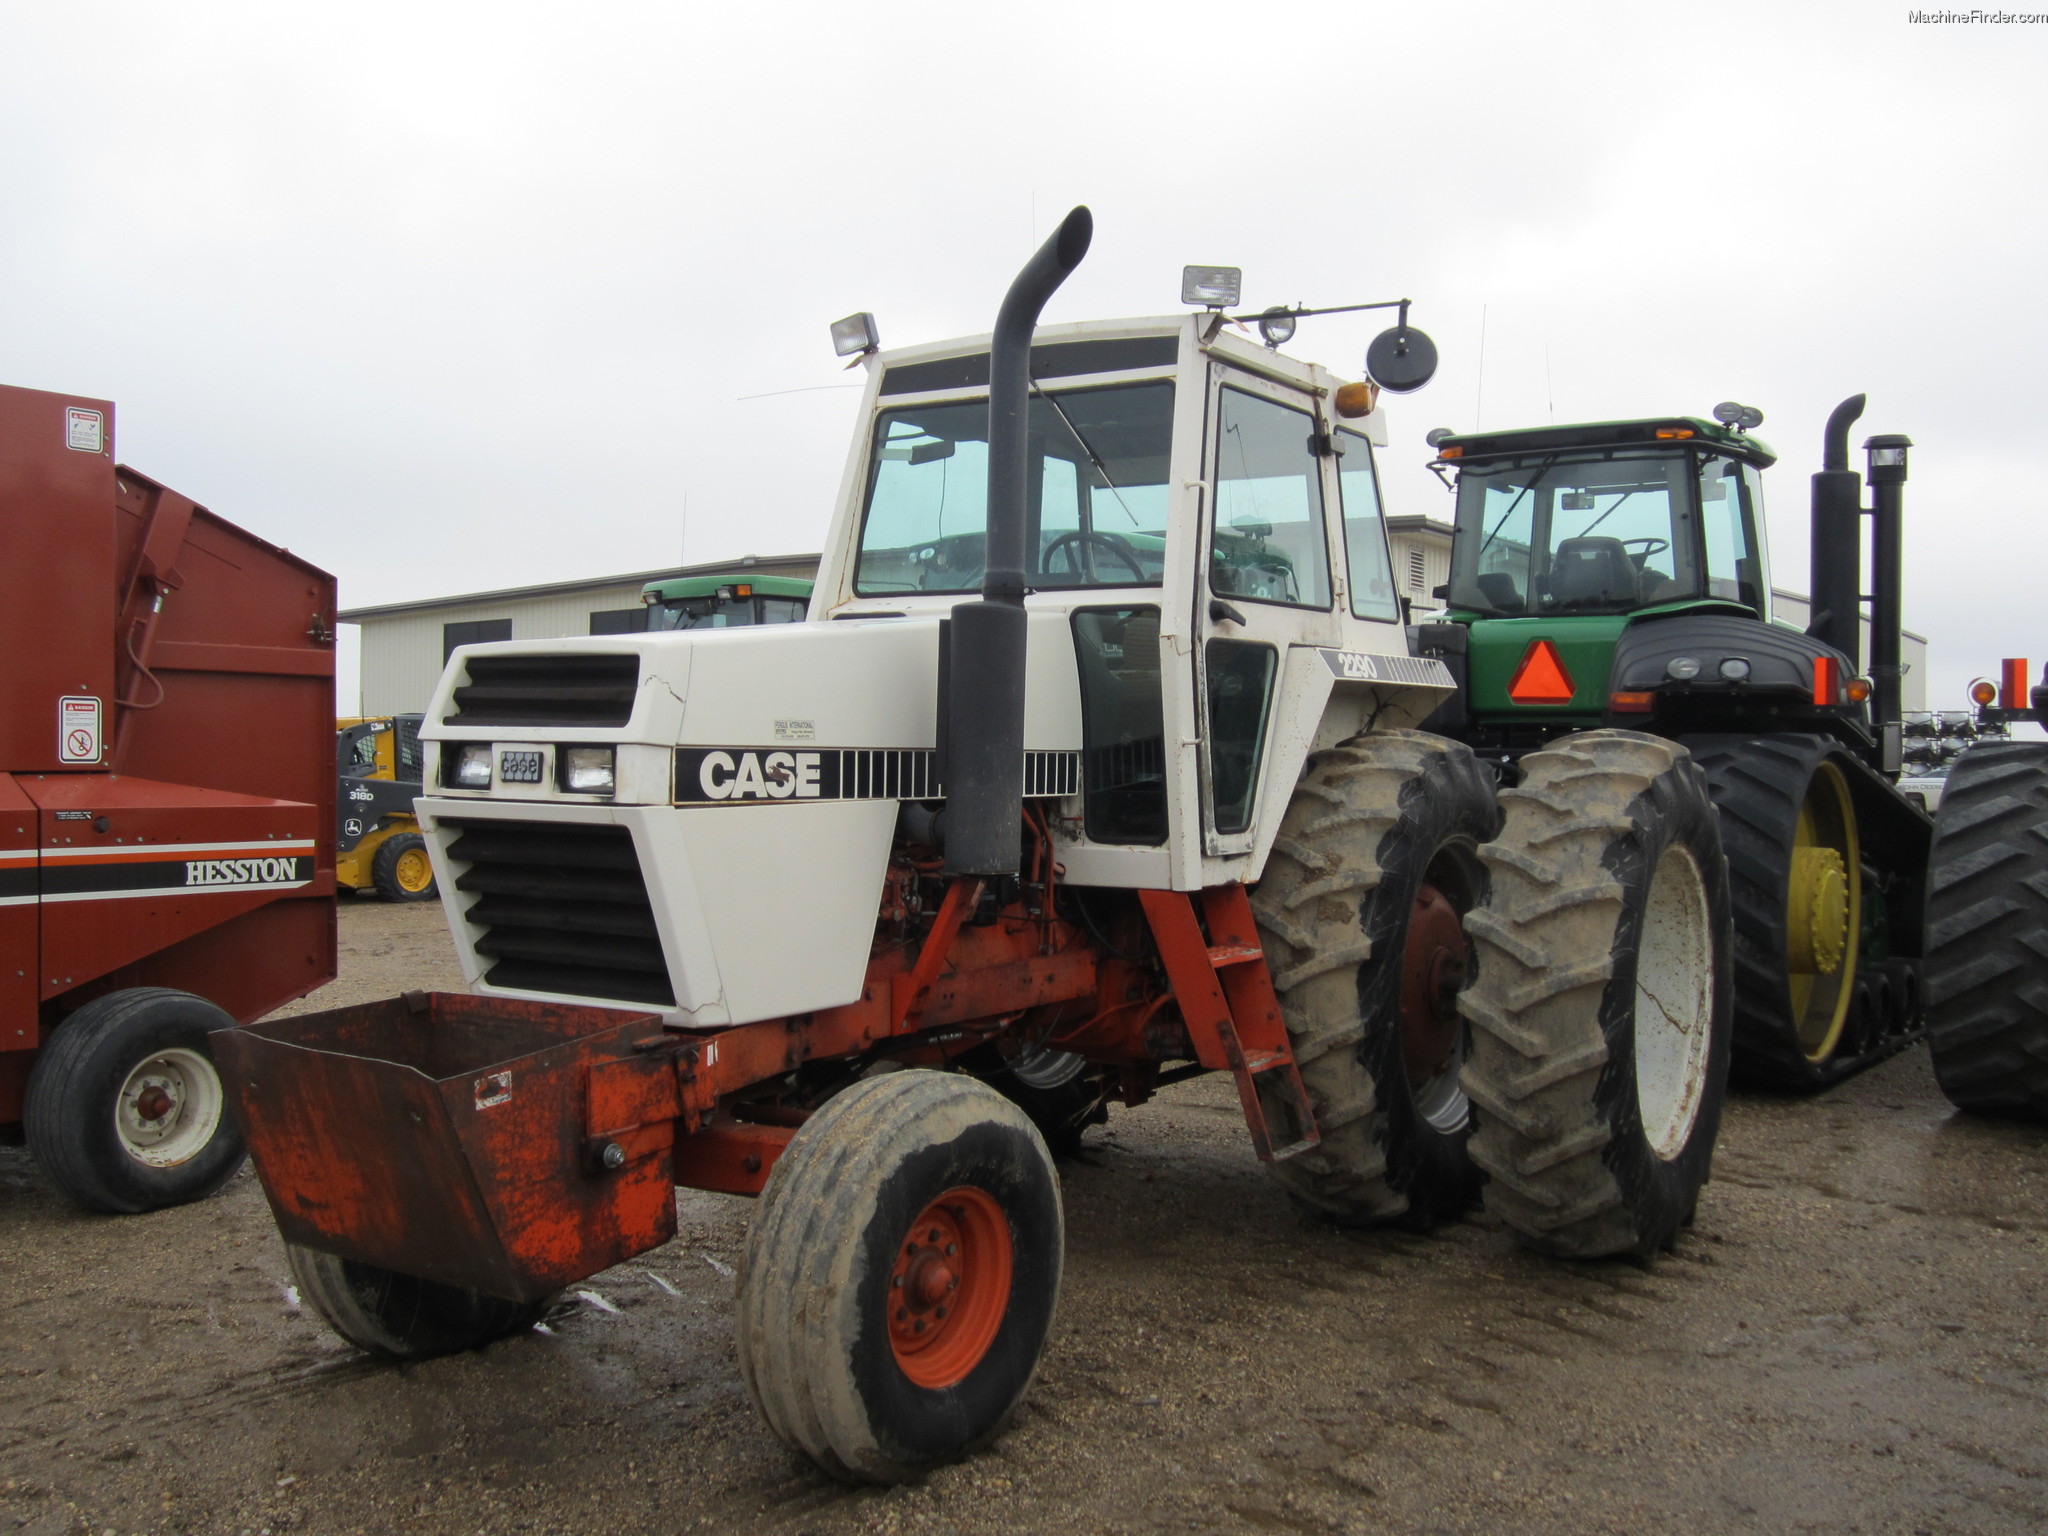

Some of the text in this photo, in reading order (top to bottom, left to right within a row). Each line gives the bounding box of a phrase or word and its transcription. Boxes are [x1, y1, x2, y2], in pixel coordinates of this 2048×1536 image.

[1338, 652, 1377, 678] 2290
[700, 751, 820, 799] CASE
[349, 791, 374, 801] 318D
[186, 858, 297, 885] HESSTON
